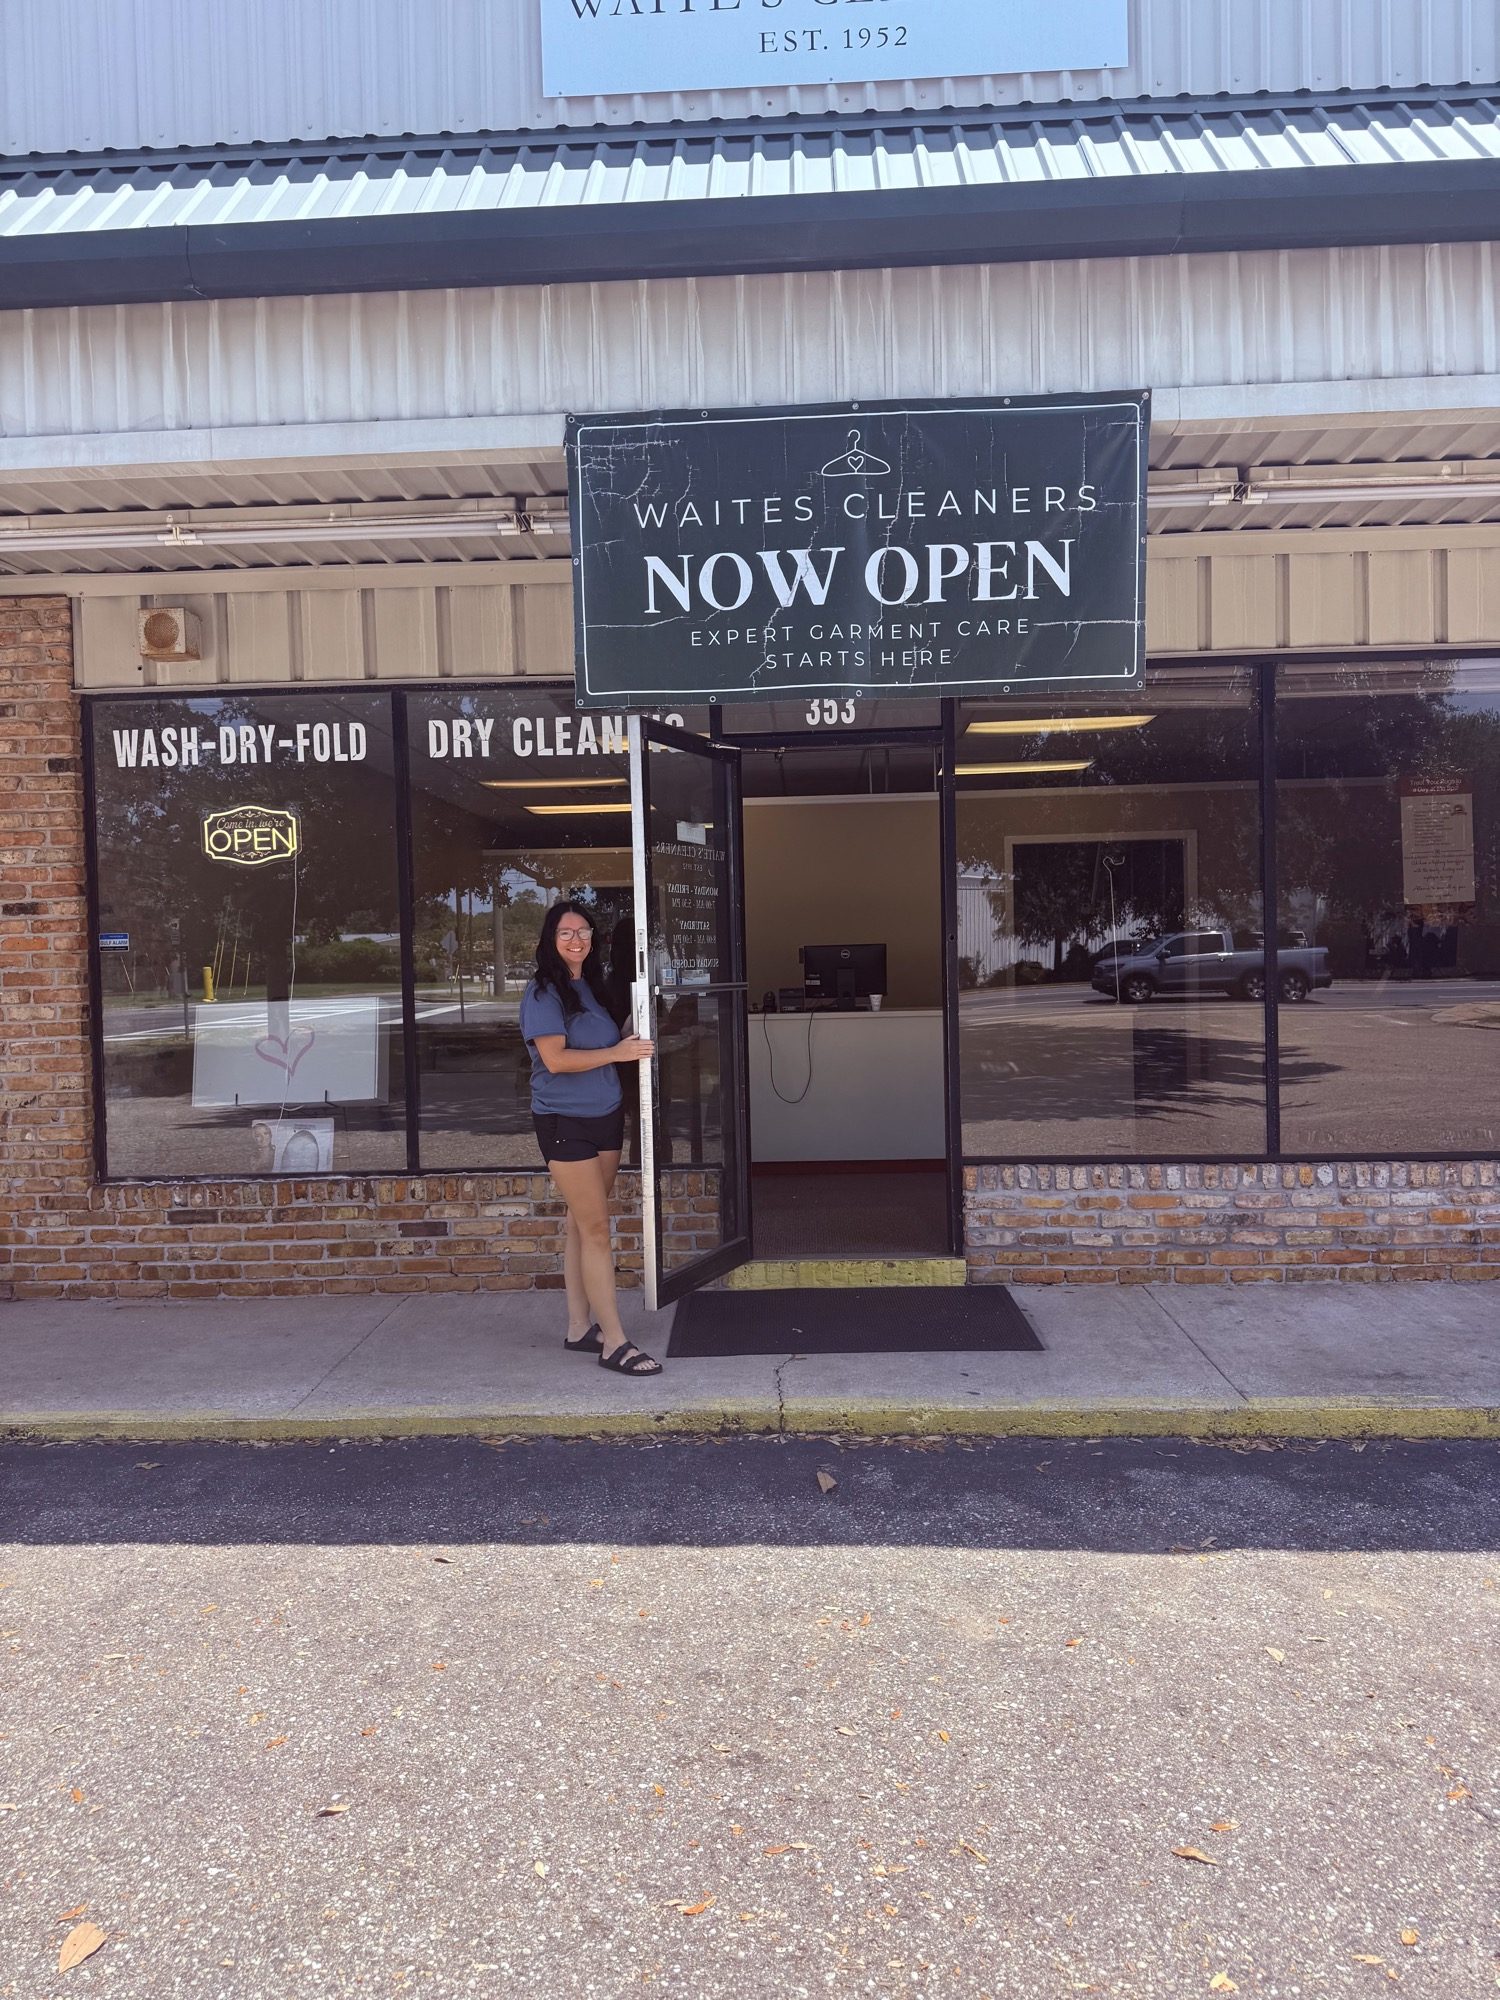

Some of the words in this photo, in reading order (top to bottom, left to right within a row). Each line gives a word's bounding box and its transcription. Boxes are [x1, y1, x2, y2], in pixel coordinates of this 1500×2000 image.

[759, 29, 828, 53] EST.
[843, 26, 908, 49] 1952
[633, 496, 813, 529] WAITES
[843, 485, 1096, 519] CLEANERS
[643, 547, 846, 614] NOW
[864, 539, 1076, 605] OPEN
[691, 626, 793, 646] EXPERT
[809, 622, 941, 640] GARMENT
[957, 618, 1029, 637] CARE
[766, 651, 865, 669] STARTS
[881, 649, 951, 667] HERE
[805, 698, 856, 725] 353
[112, 722, 367, 768] WASH-DRY-FOLD
[428, 718, 495, 758] DRY
[209, 827, 293, 852] OPEN
